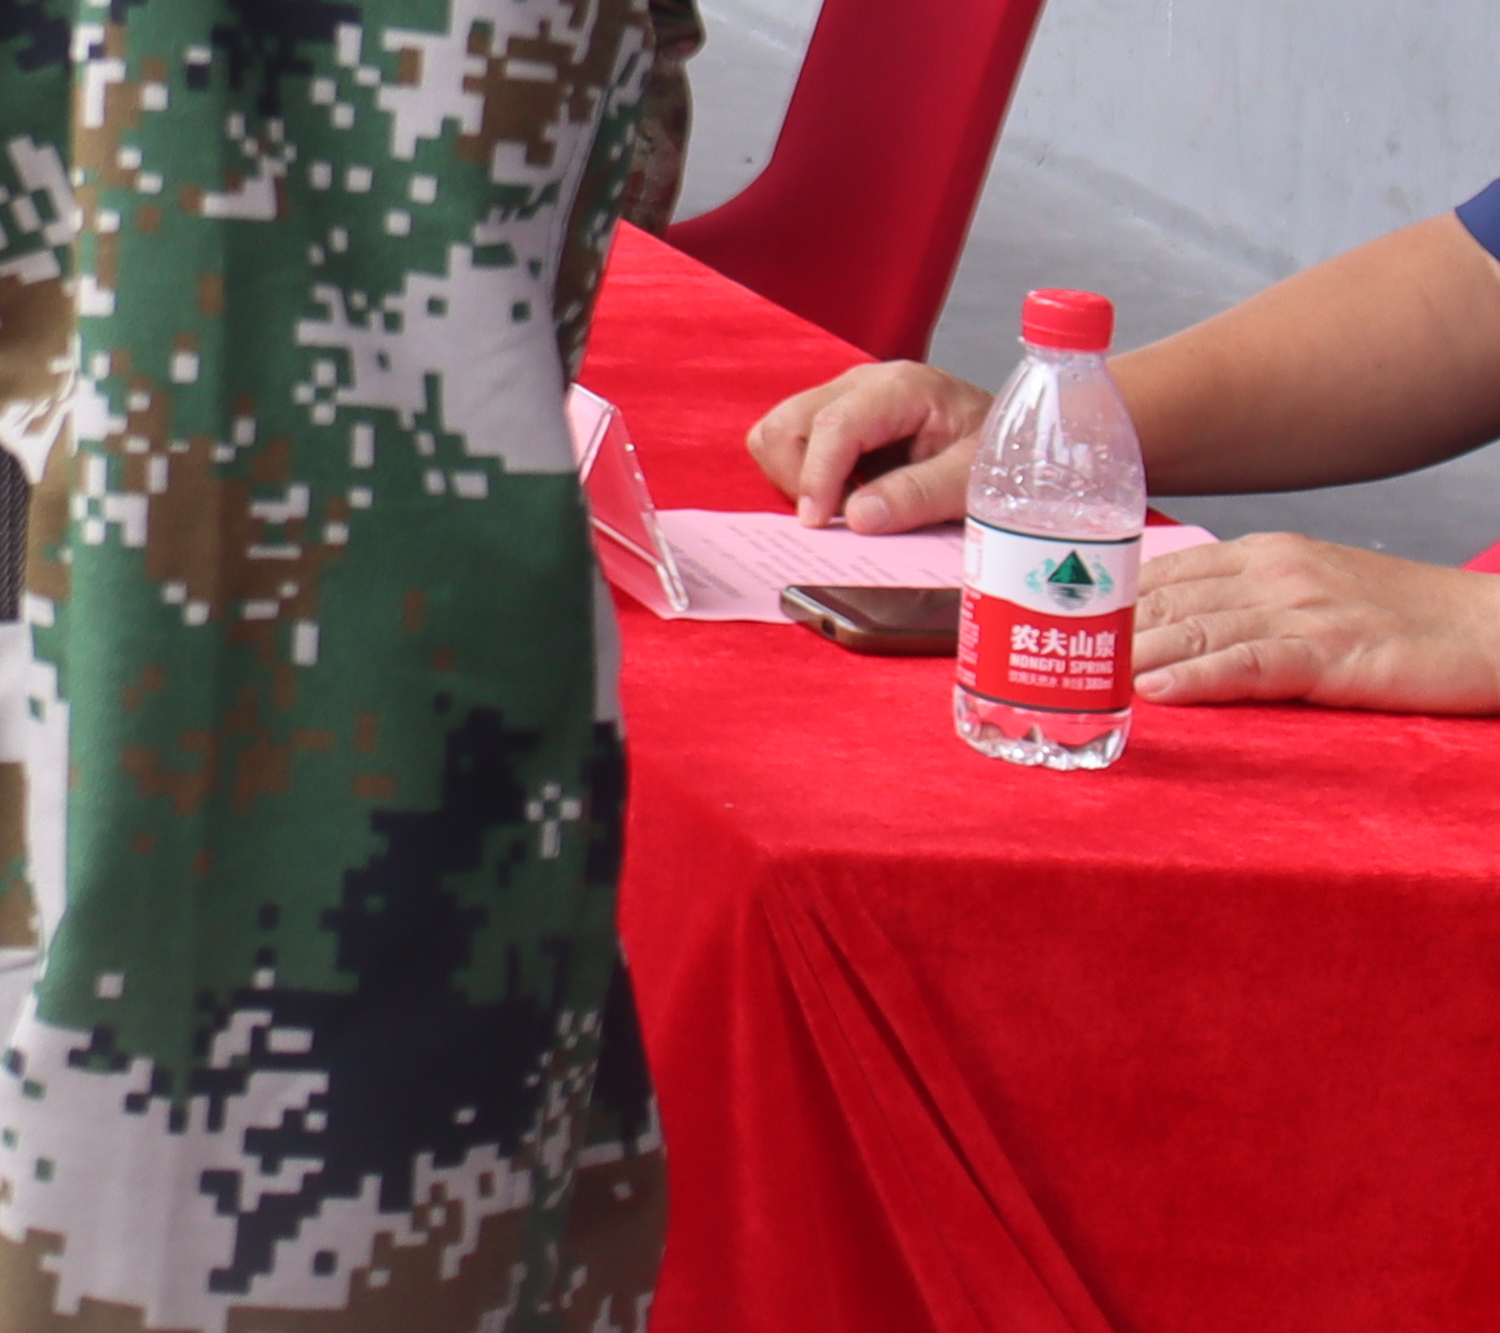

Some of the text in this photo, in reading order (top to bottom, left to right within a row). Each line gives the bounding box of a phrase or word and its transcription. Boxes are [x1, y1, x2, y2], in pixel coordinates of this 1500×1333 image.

[1010, 624, 1116, 658] 农夫山泉
[1009, 652, 1114, 675] NONGFU SPRING
